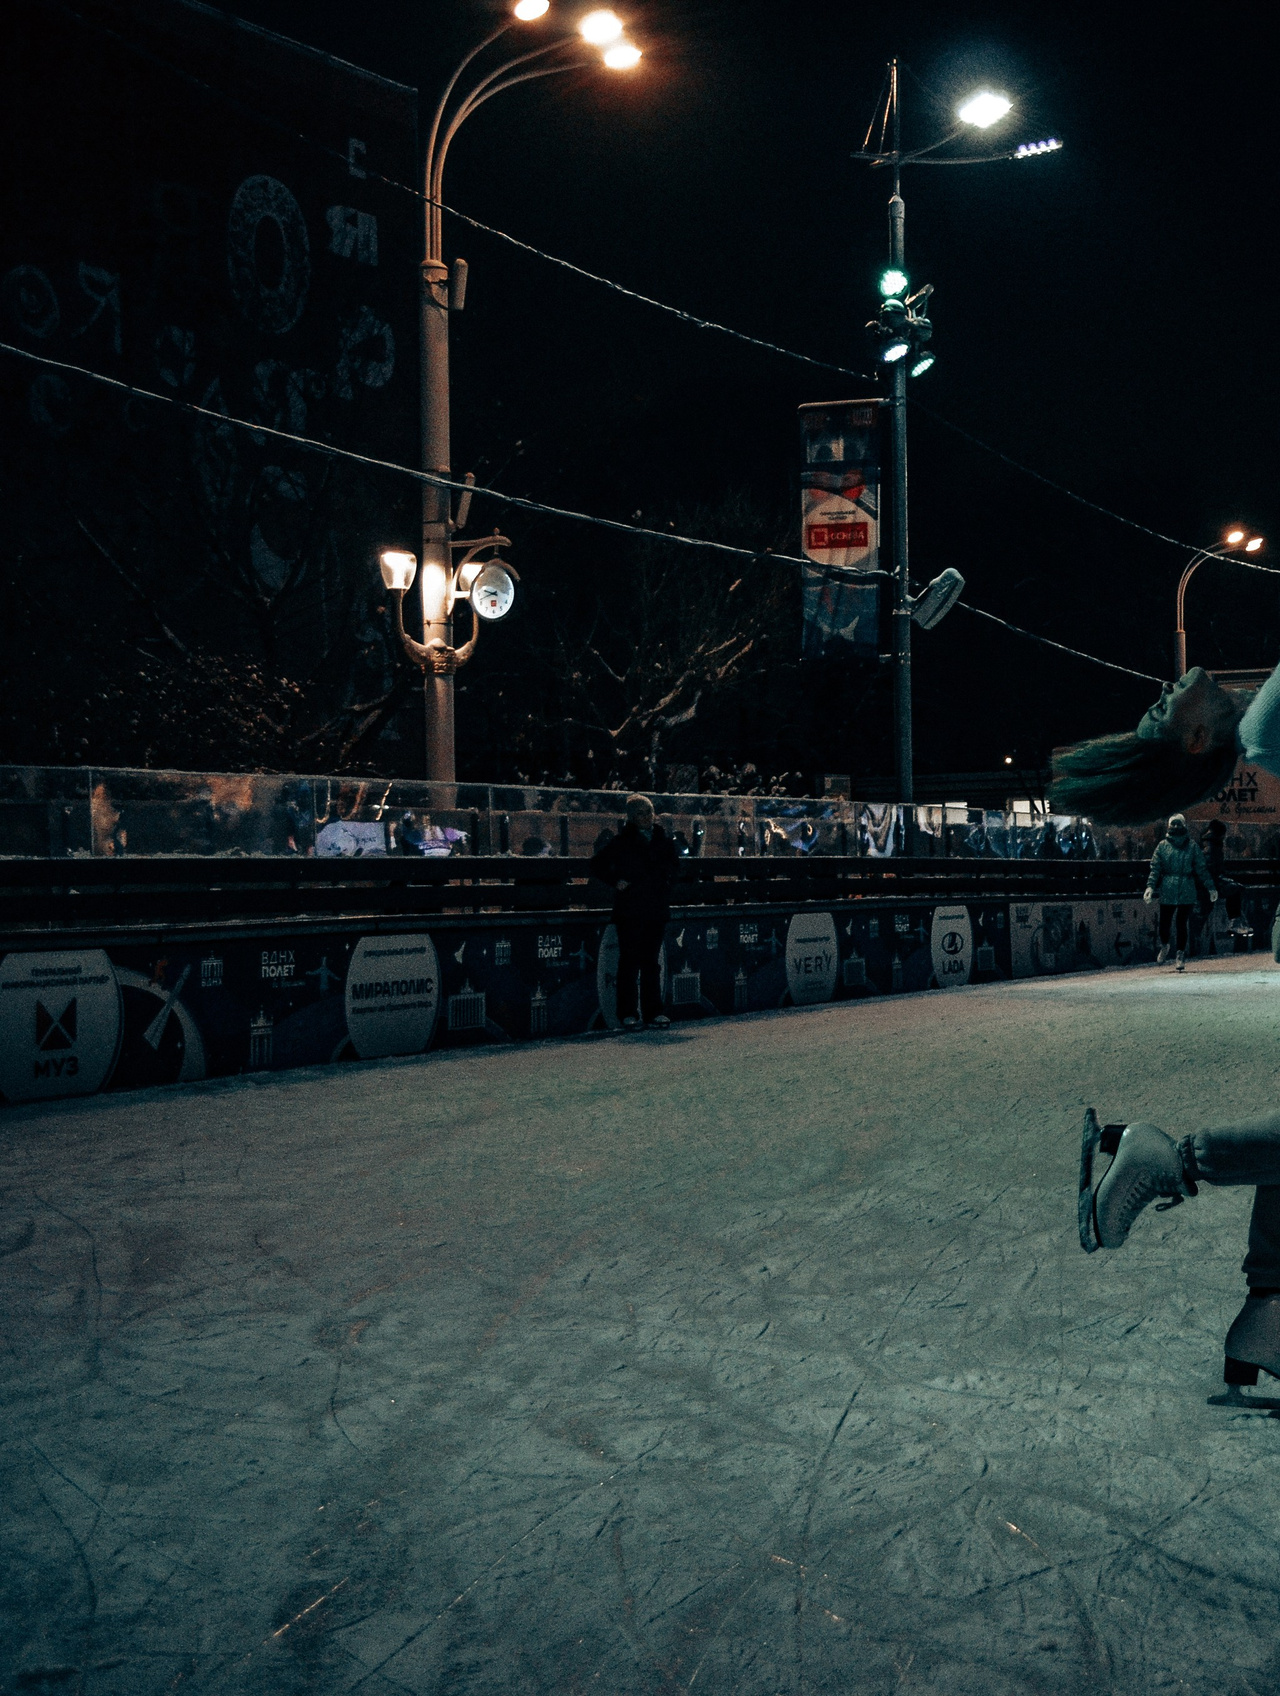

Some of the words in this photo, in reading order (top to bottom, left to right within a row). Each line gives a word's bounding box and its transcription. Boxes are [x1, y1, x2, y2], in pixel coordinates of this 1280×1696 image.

[1210, 788, 1258, 802] ОЛЕТ
[538, 935, 562, 947] ВДНХ
[261, 950, 295, 965] ВДНХ
[538, 947, 562, 958] ПОЛЕТ
[793, 949, 832, 974] VERY
[942, 960, 965, 975] LADA
[261, 964, 295, 978] ПОЛЕТ
[352, 978, 434, 1000] МИРАПОЛИС
[34, 1057, 79, 1079] МУЗ
